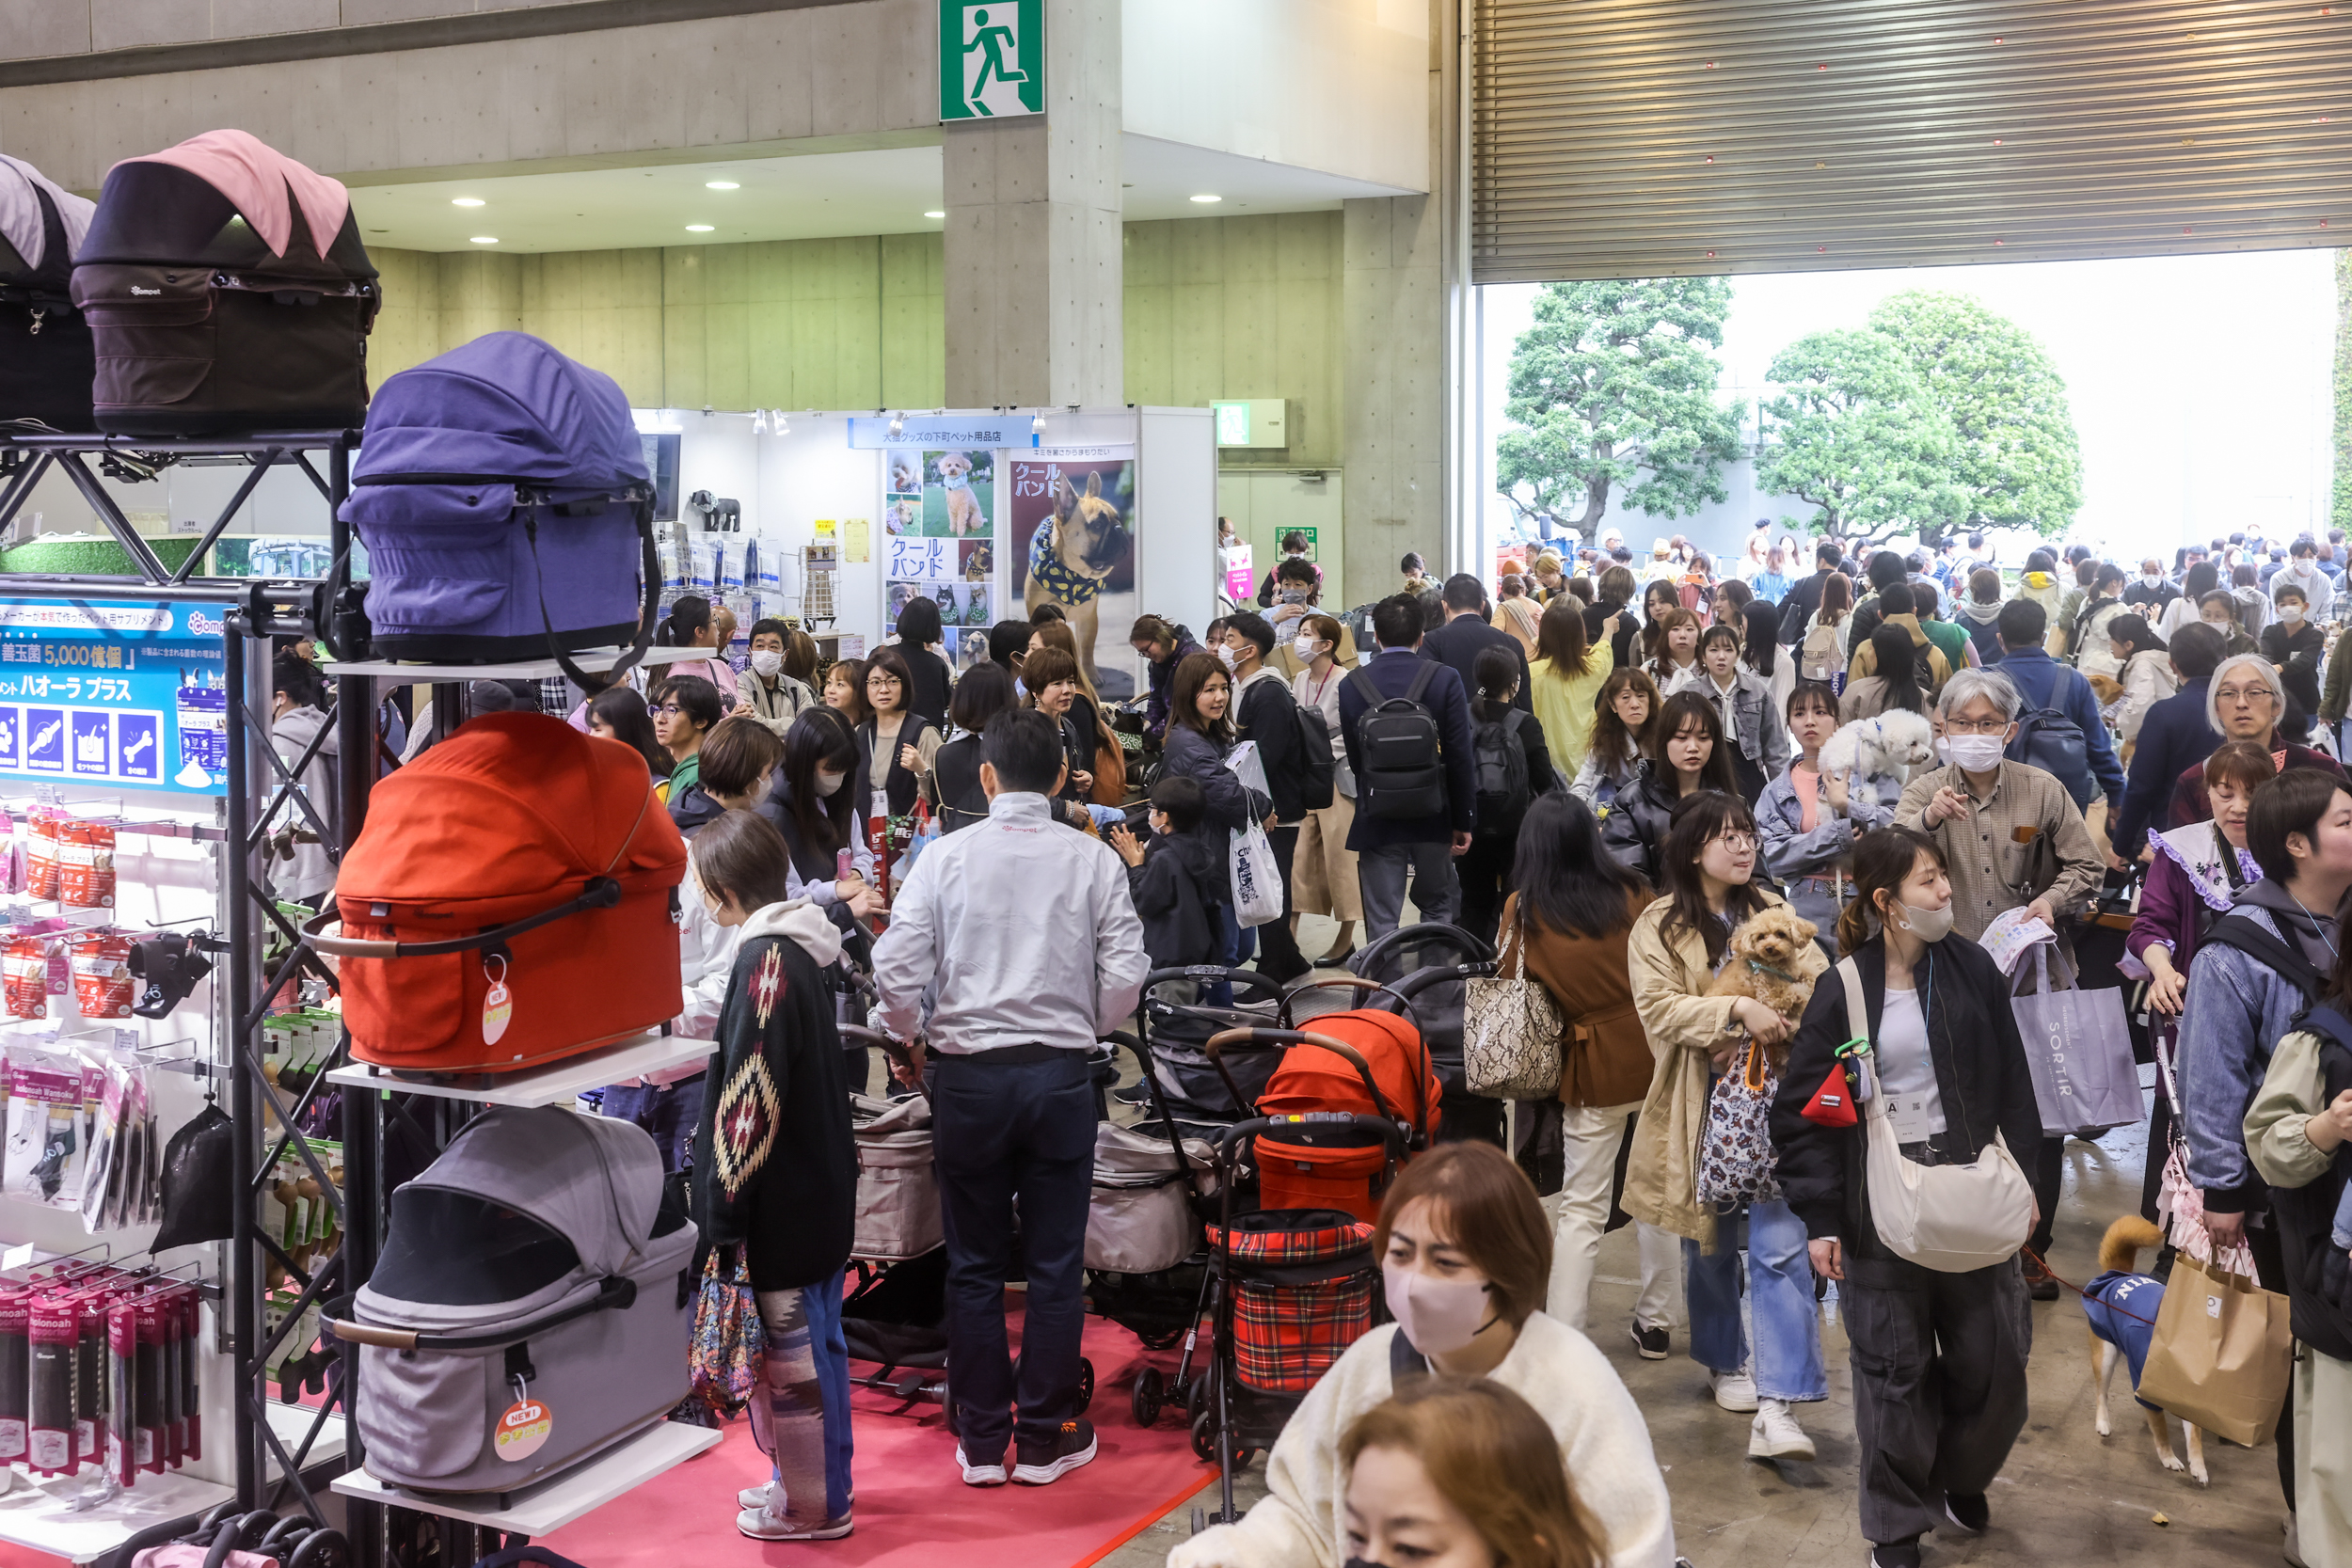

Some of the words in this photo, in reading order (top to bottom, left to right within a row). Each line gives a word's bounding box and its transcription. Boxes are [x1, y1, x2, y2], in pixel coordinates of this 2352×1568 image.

[1016, 463, 1061, 481] クール
[1015, 481, 1061, 498] バンド
[891, 538, 944, 557] クール
[891, 558, 944, 577] バンド
[20, 674, 82, 699] ハオーラ
[86, 676, 132, 701] プラス
[2049, 1022, 2073, 1097] SORTIR
[1887, 1102, 1898, 1113] A
